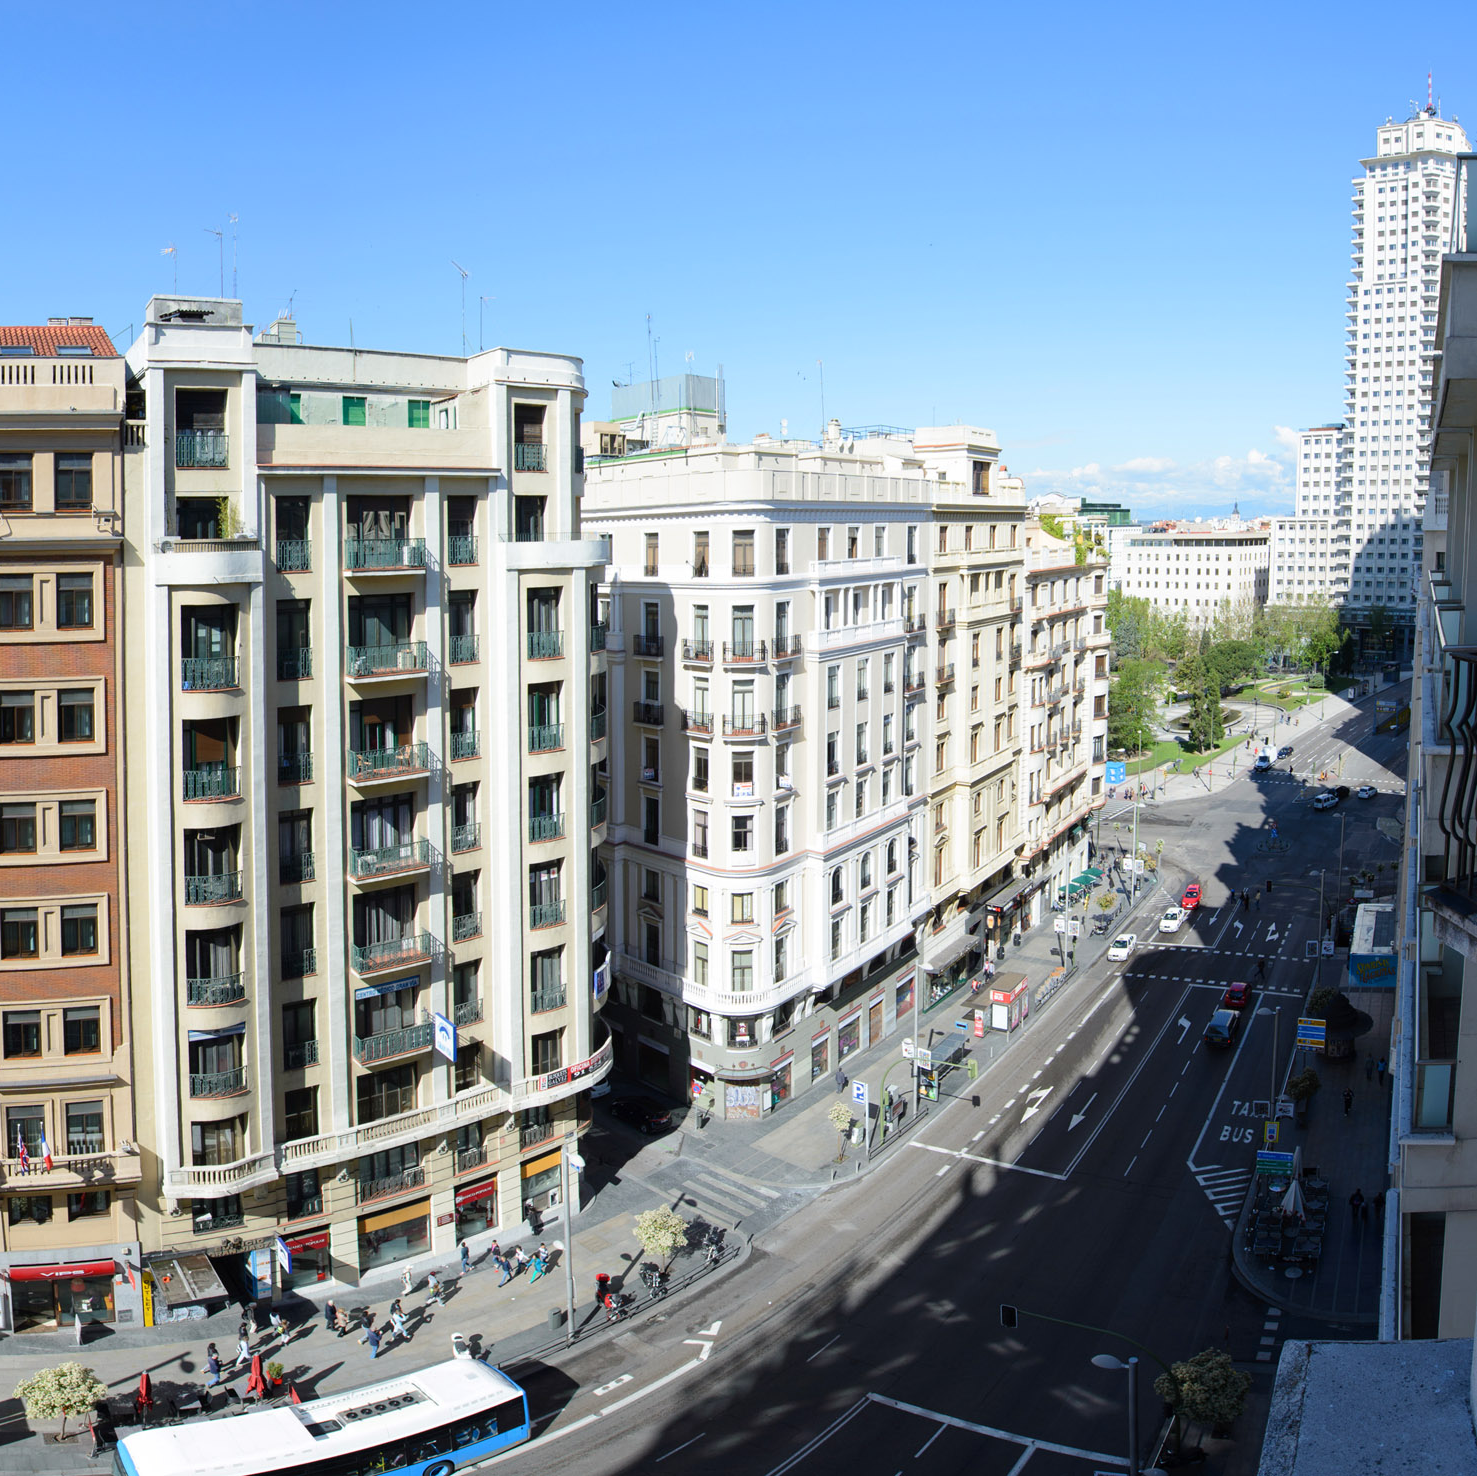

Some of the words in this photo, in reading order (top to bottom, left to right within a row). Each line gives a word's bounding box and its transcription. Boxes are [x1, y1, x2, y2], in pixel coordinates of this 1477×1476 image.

[570, 1060, 590, 1073] OFICINA
[573, 1069, 586, 1078] 91
[1219, 1125, 1254, 1143] BUS
[476, 1186, 492, 1195] POPULAR
[305, 1238, 325, 1246] POPULAR
[40, 1269, 85, 1277] VIPS
